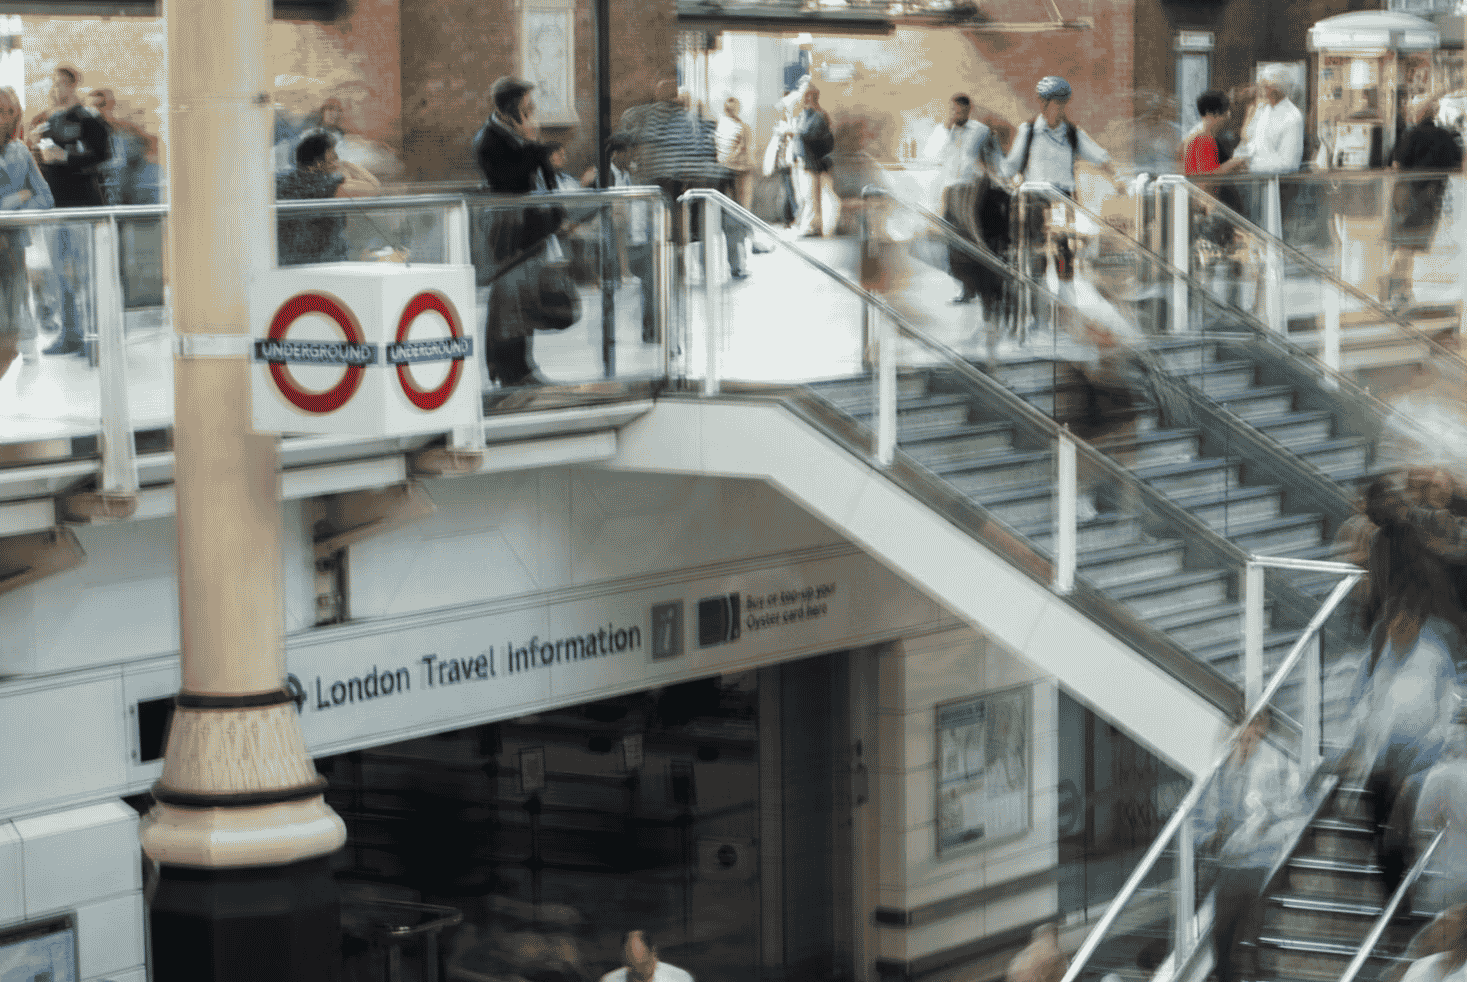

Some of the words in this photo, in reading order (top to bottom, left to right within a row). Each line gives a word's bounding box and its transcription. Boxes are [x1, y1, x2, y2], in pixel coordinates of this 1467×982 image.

[261, 341, 371, 360] UNDERGROUND
[391, 339, 469, 360] UNDERGROUND
[315, 664, 412, 711] London
[422, 645, 496, 687] Travel
[508, 622, 643, 674] Information
